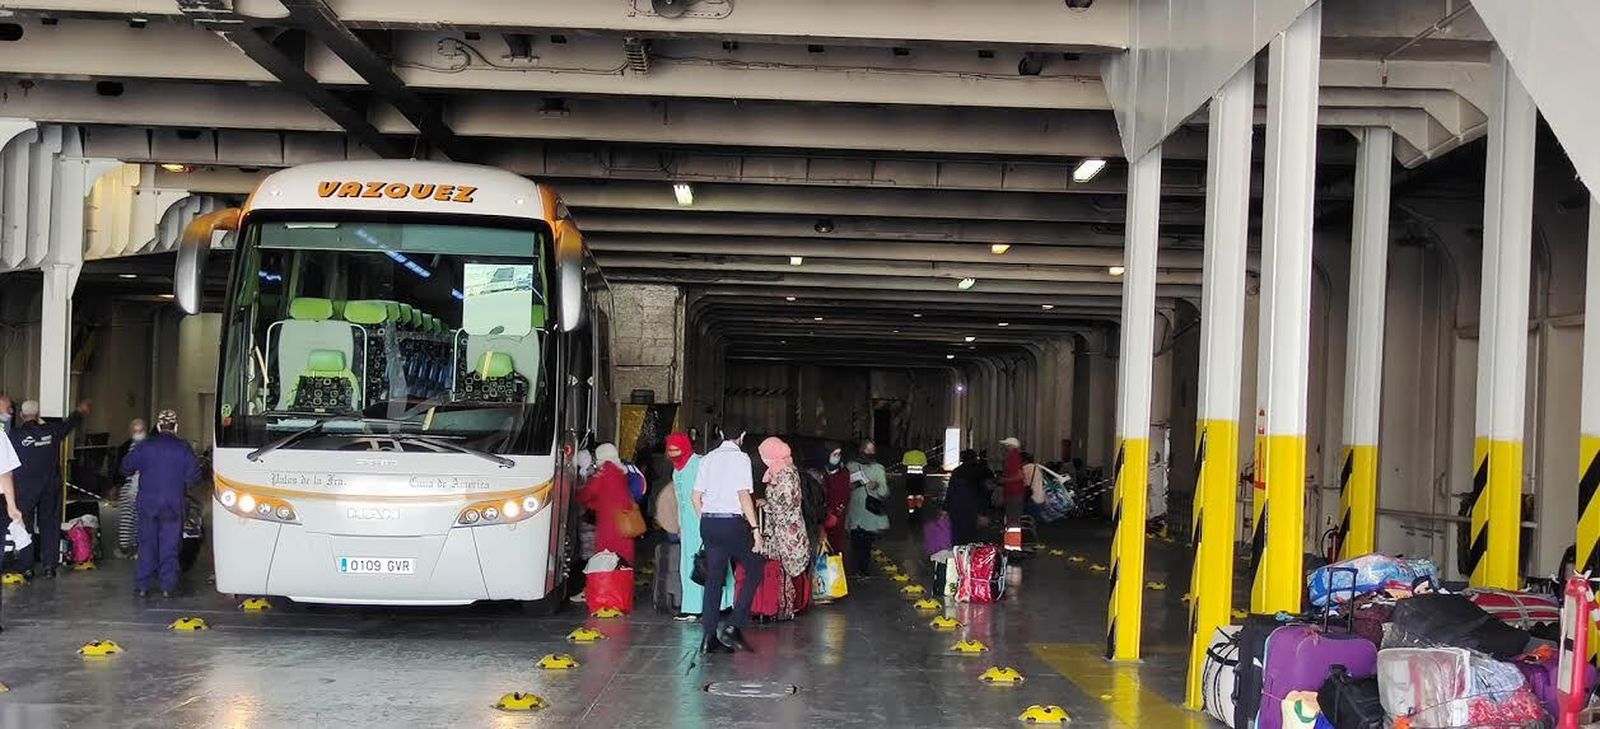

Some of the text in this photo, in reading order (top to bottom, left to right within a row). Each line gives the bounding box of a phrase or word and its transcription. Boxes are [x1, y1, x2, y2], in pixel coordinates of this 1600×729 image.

[317, 181, 478, 203] VAZQUEZ
[270, 472, 298, 487] Palos
[301, 472, 311, 486] de
[314, 473, 322, 486] la
[437, 478, 447, 489] de
[350, 559, 410, 572] 0109 GVR
